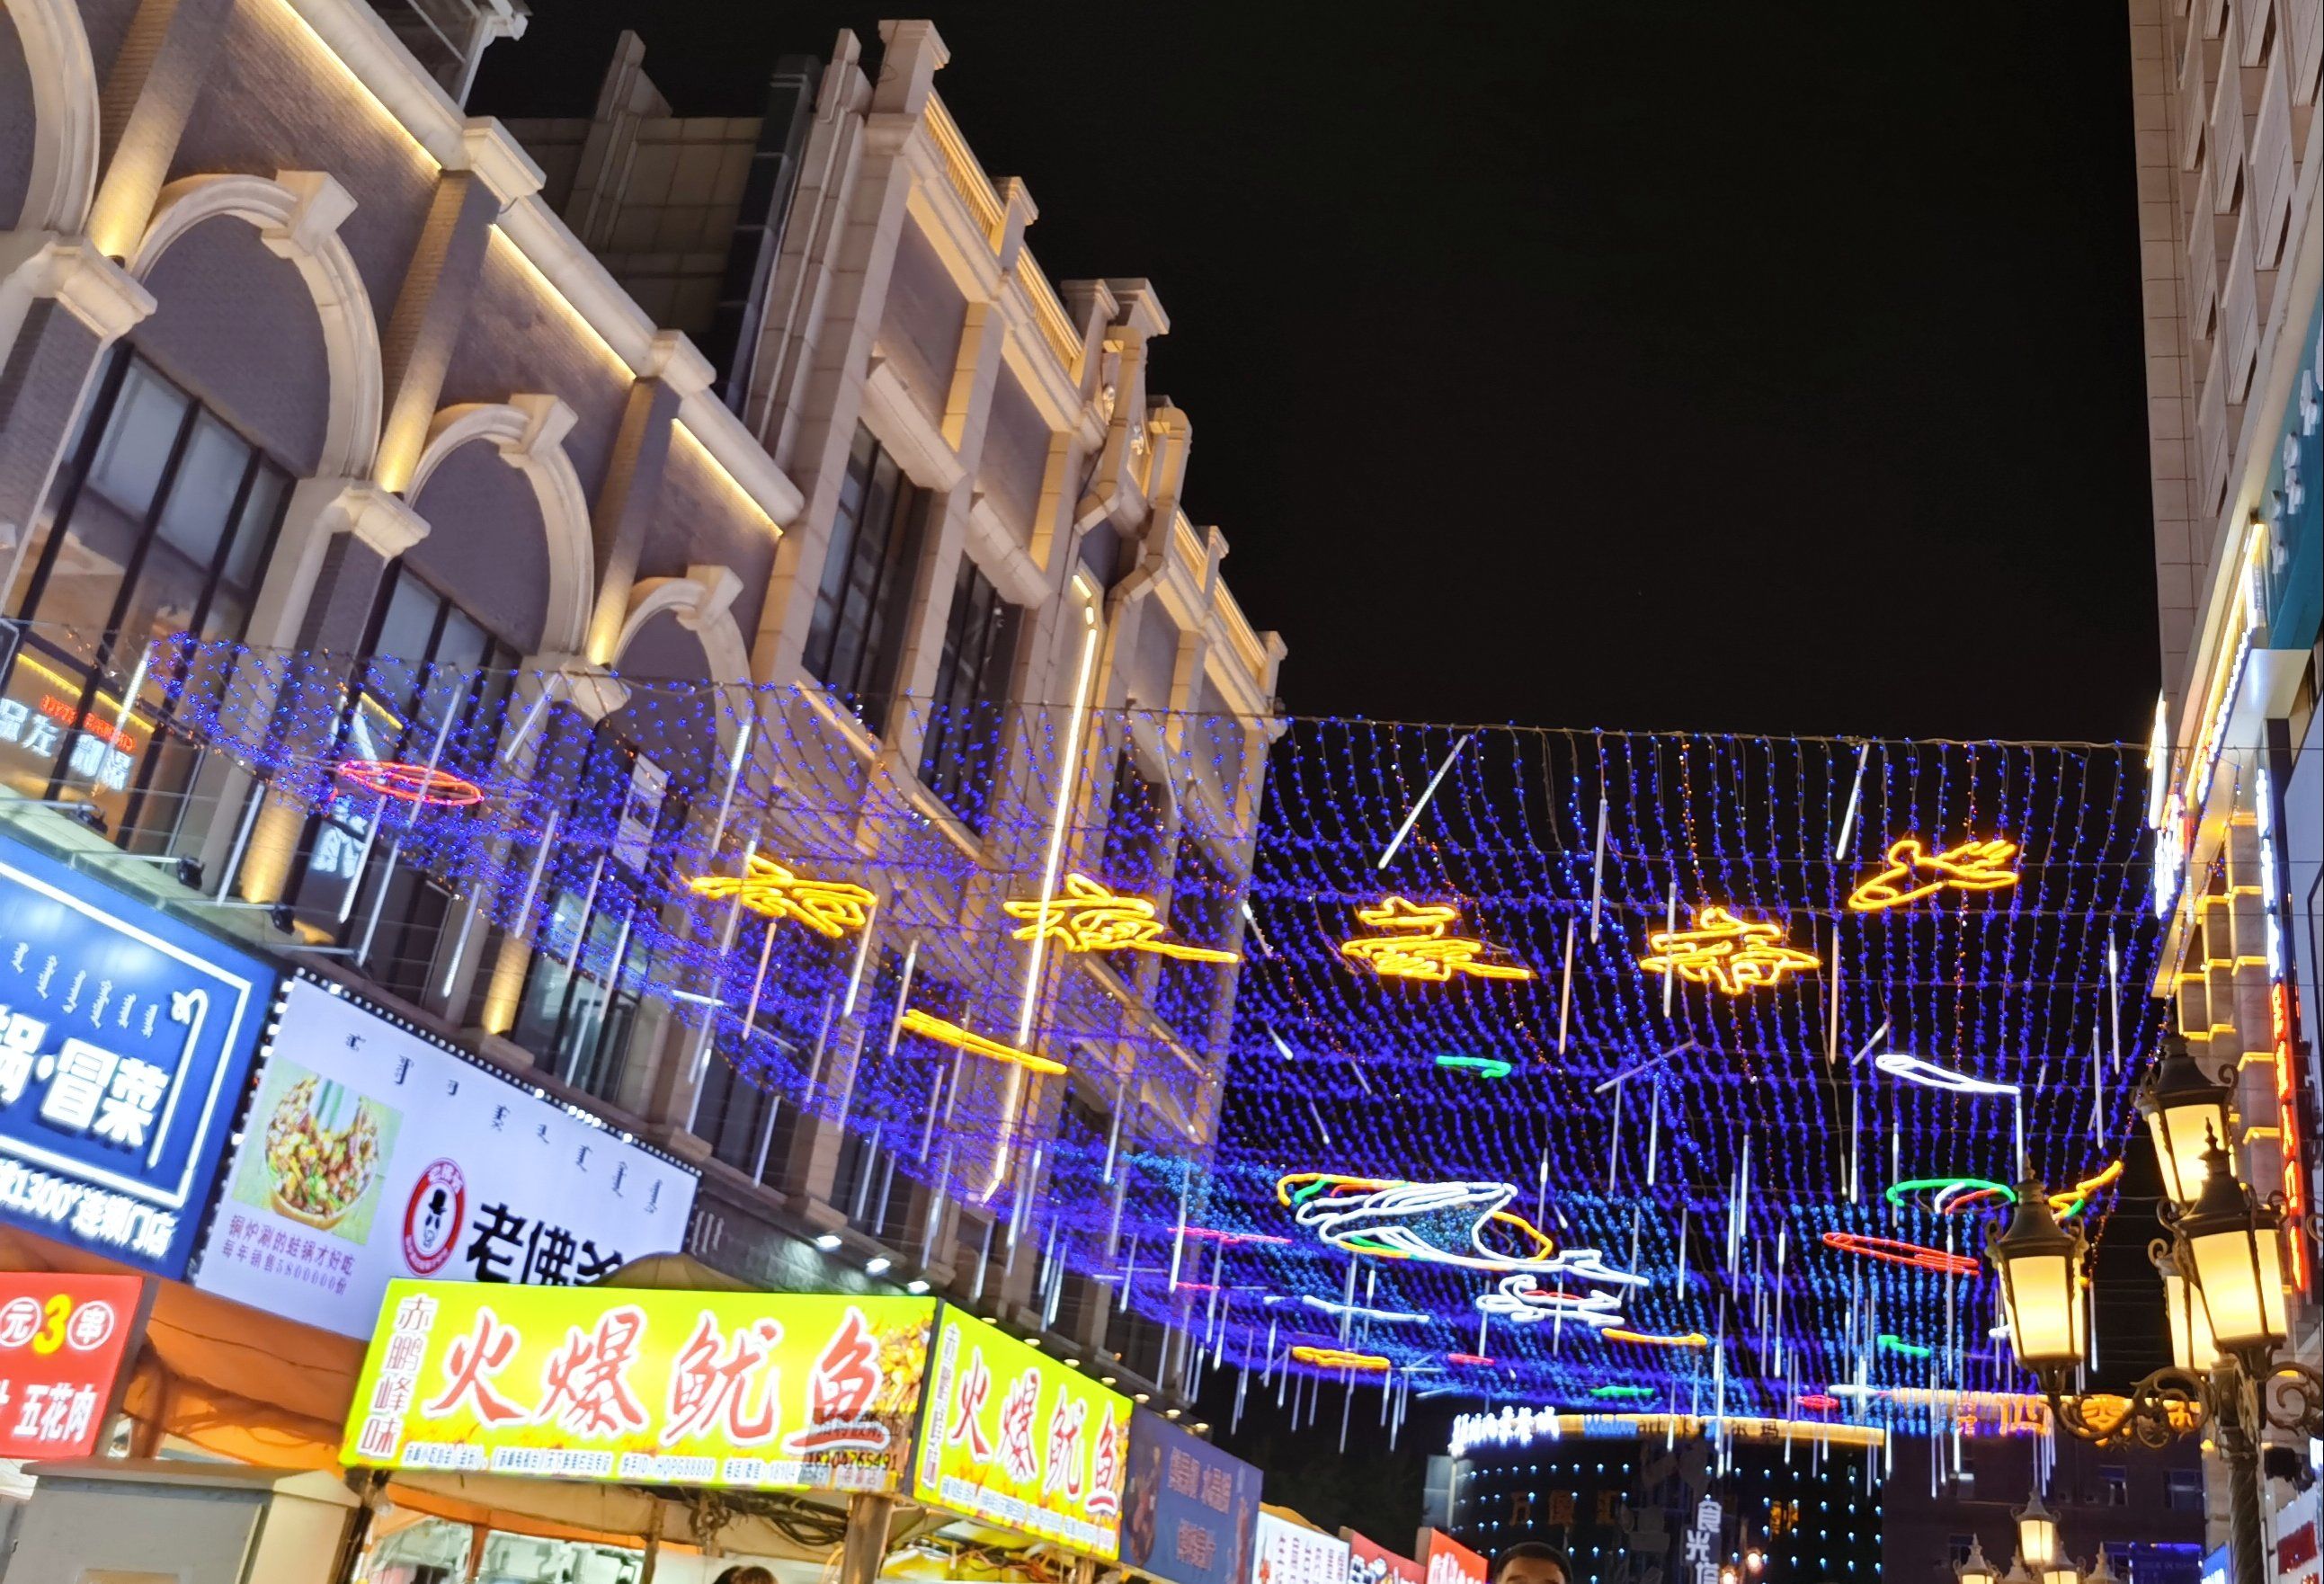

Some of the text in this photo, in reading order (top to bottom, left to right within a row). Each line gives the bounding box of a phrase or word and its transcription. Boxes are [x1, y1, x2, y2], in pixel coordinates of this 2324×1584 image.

[13, 1381, 98, 1443] 五花肉
[361, 1296, 436, 1455] 赤鹏峰味
[425, 1305, 890, 1450] 火爆鱿鱼
[949, 1347, 1119, 1516] 火爆鱿鱼
